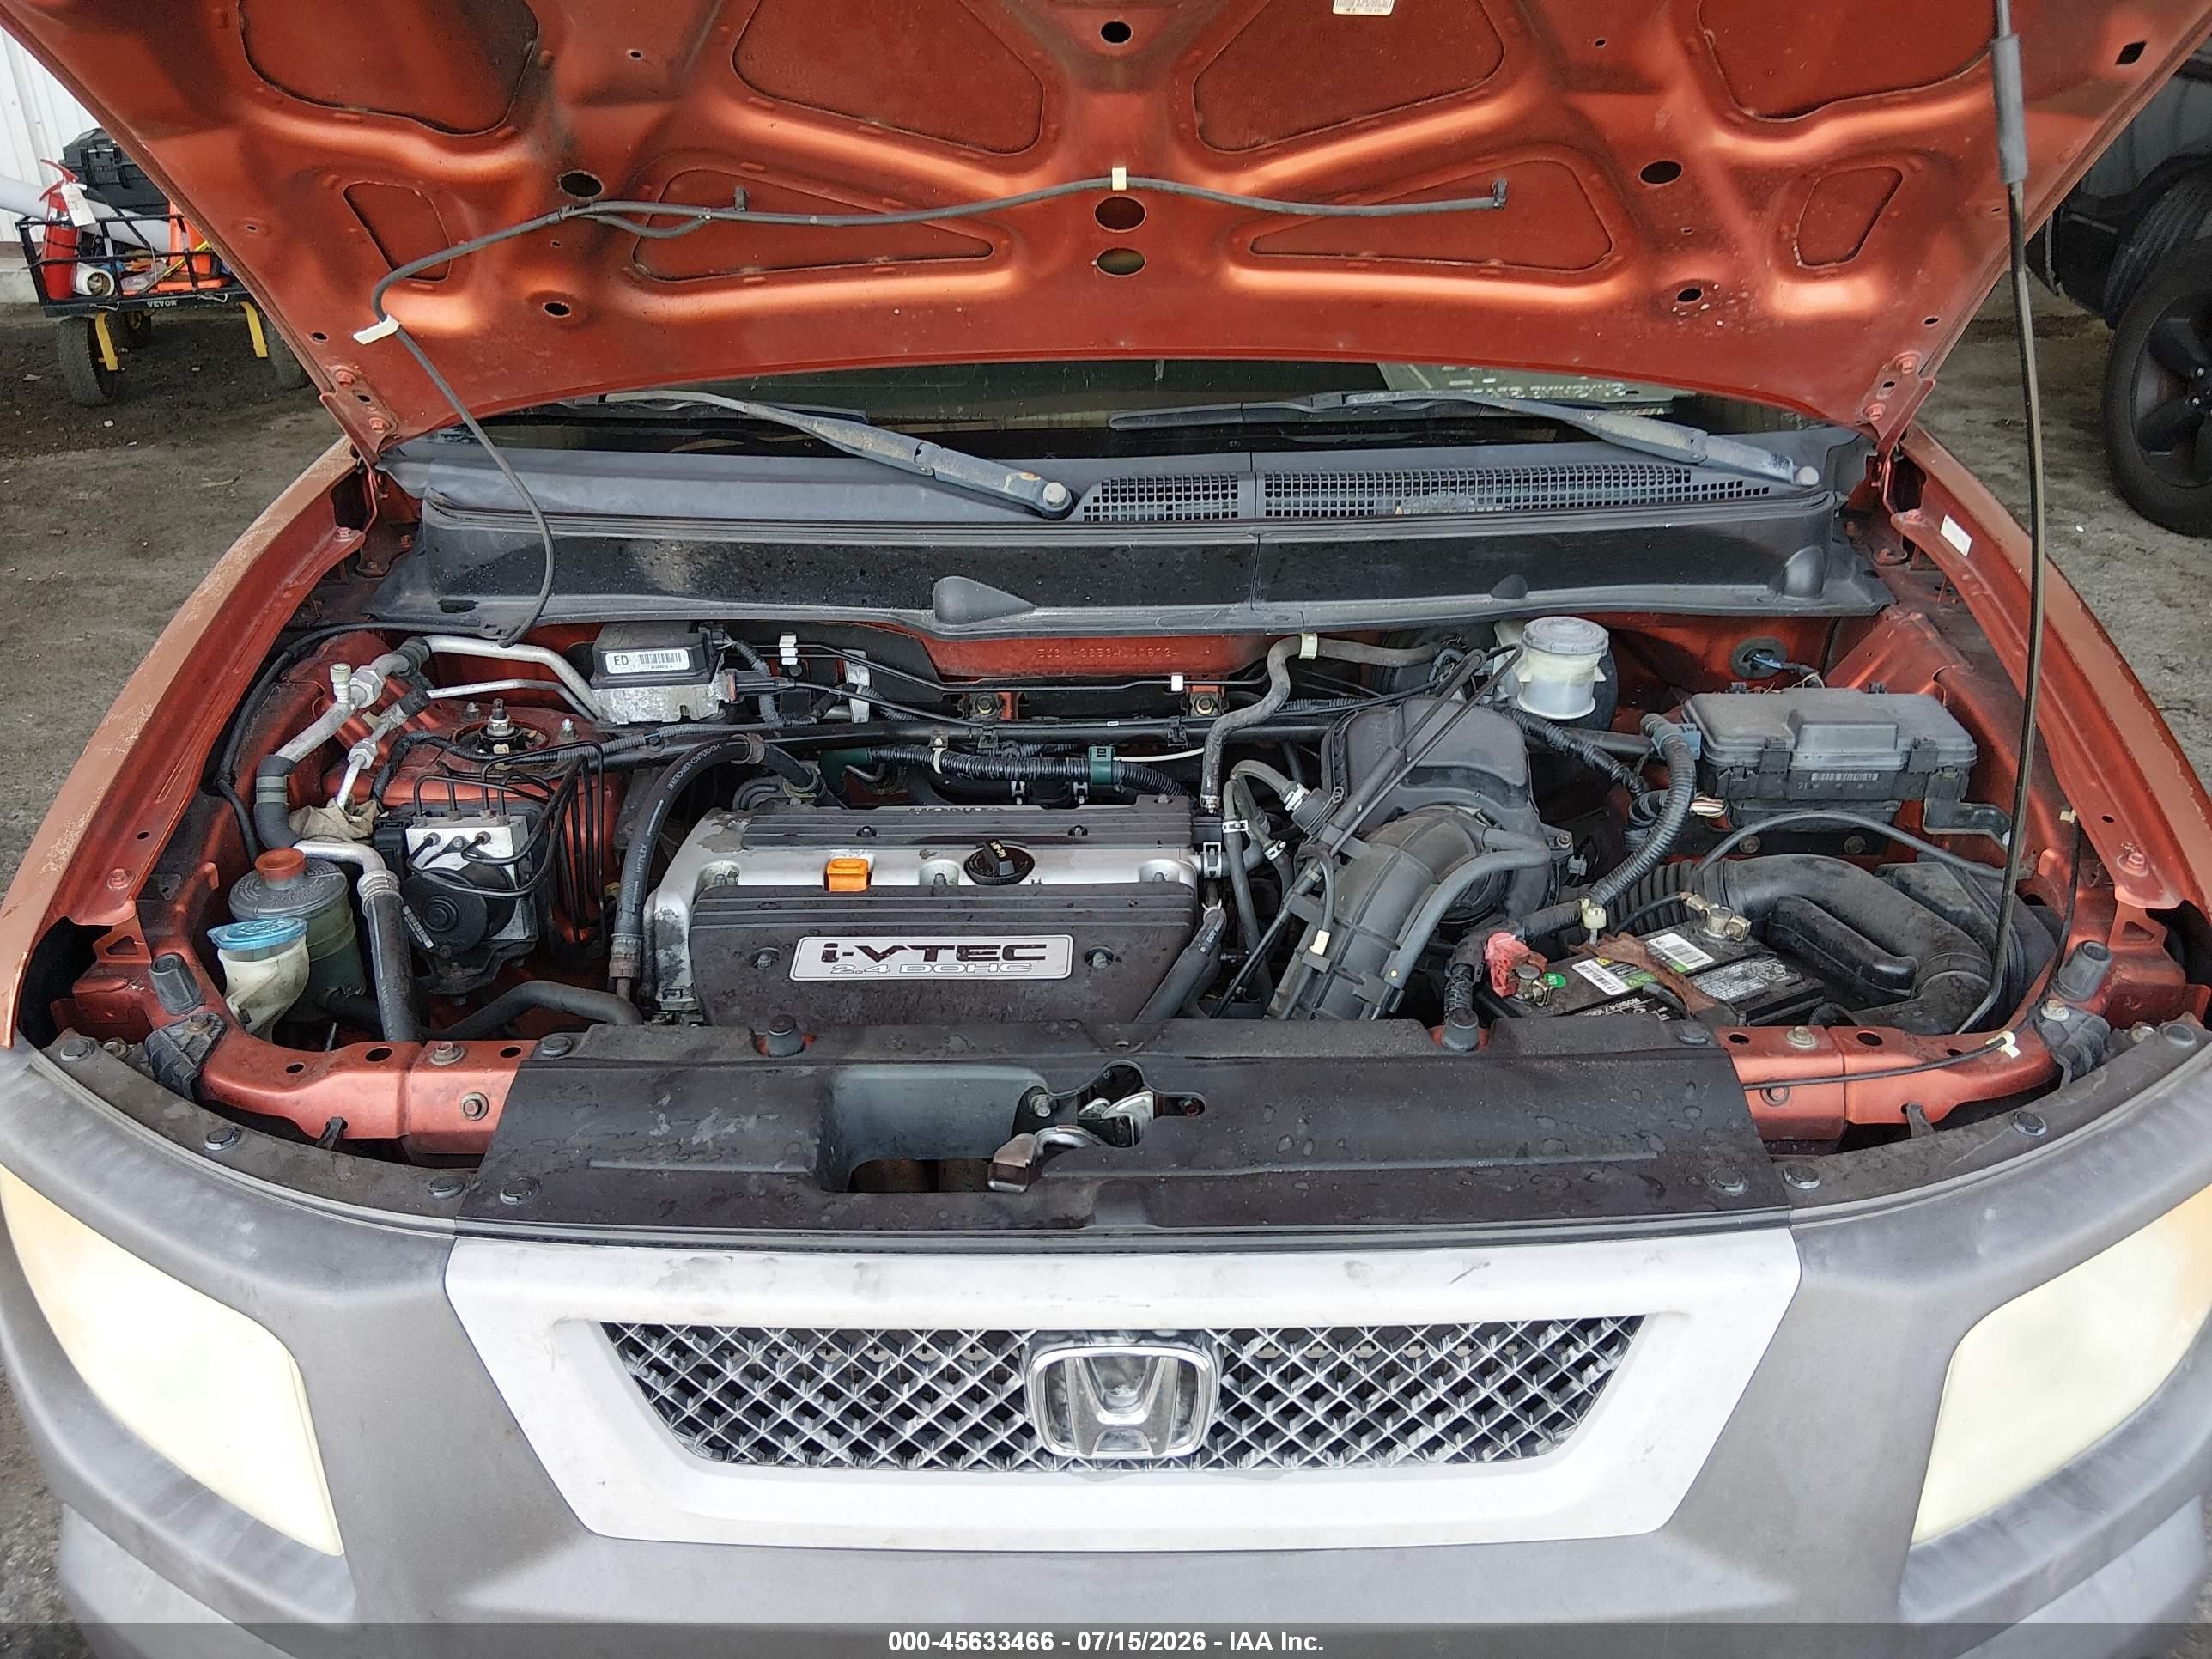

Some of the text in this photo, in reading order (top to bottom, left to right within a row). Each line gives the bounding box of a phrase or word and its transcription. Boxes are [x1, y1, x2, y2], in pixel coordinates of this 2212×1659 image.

[613, 654, 629, 666] ED
[821, 942, 1048, 963] i-VTEC
[830, 963, 1032, 975] 2.4 DOHC
